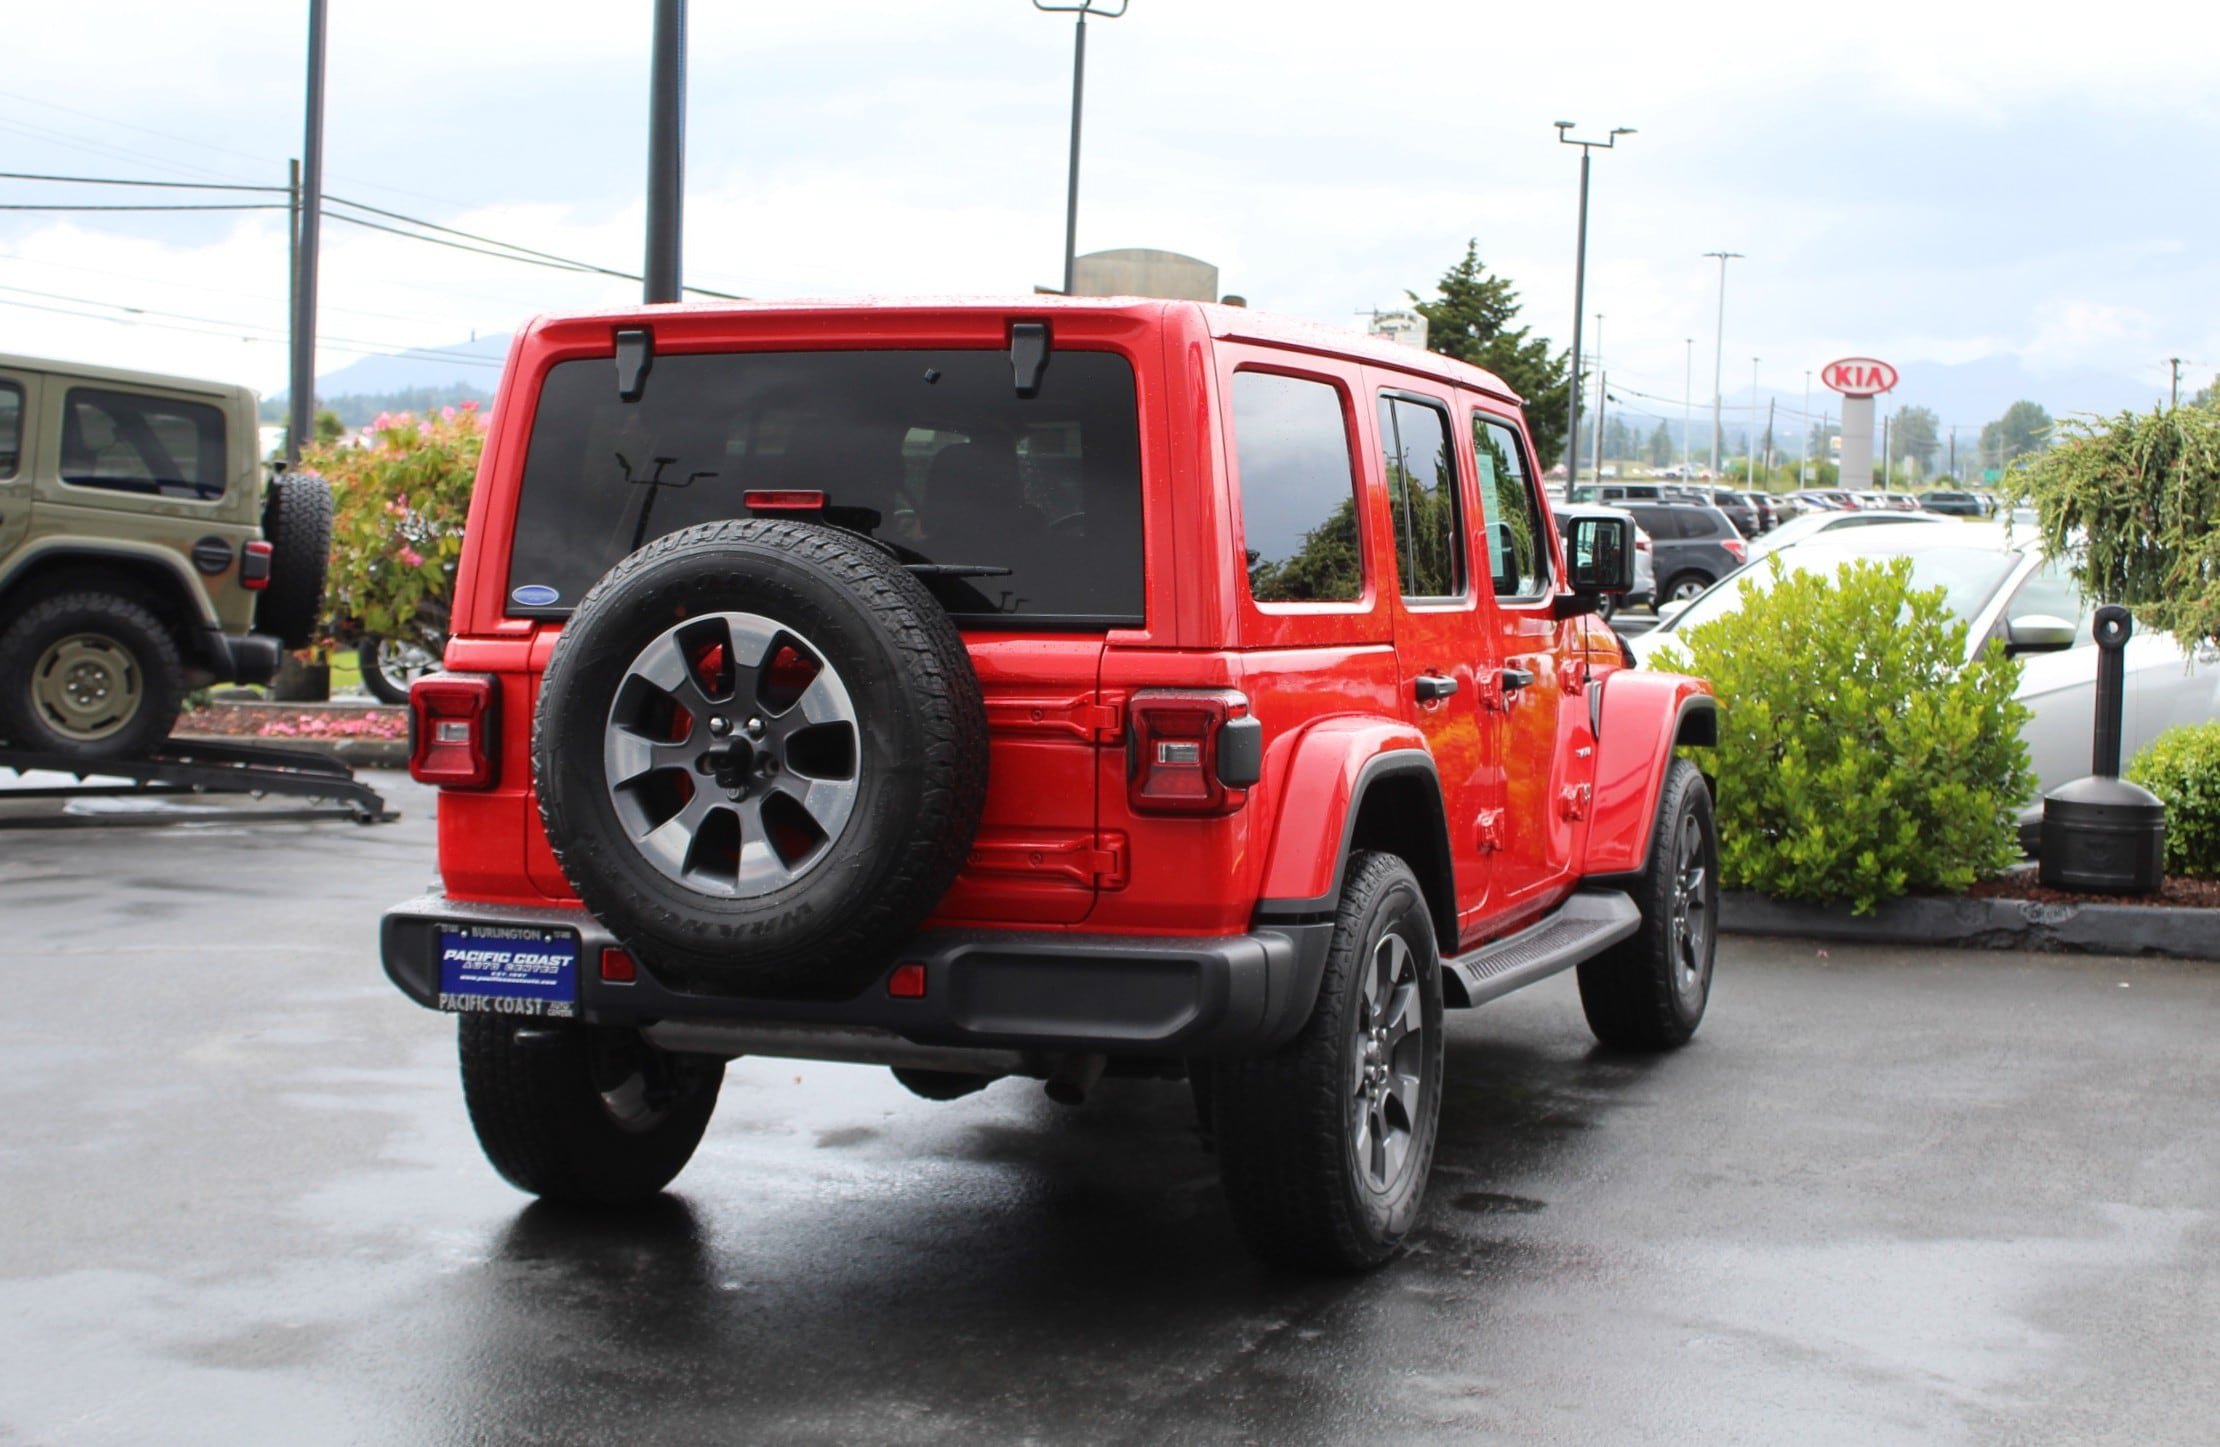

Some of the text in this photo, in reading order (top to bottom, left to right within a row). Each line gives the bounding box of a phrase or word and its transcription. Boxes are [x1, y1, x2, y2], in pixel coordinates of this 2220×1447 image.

[1835, 366, 1884, 387] KIA
[472, 927, 541, 940] BURLINGTON
[443, 949, 573, 966] PACIFIC COAST
[438, 993, 542, 1015] PACIFIC COAST
